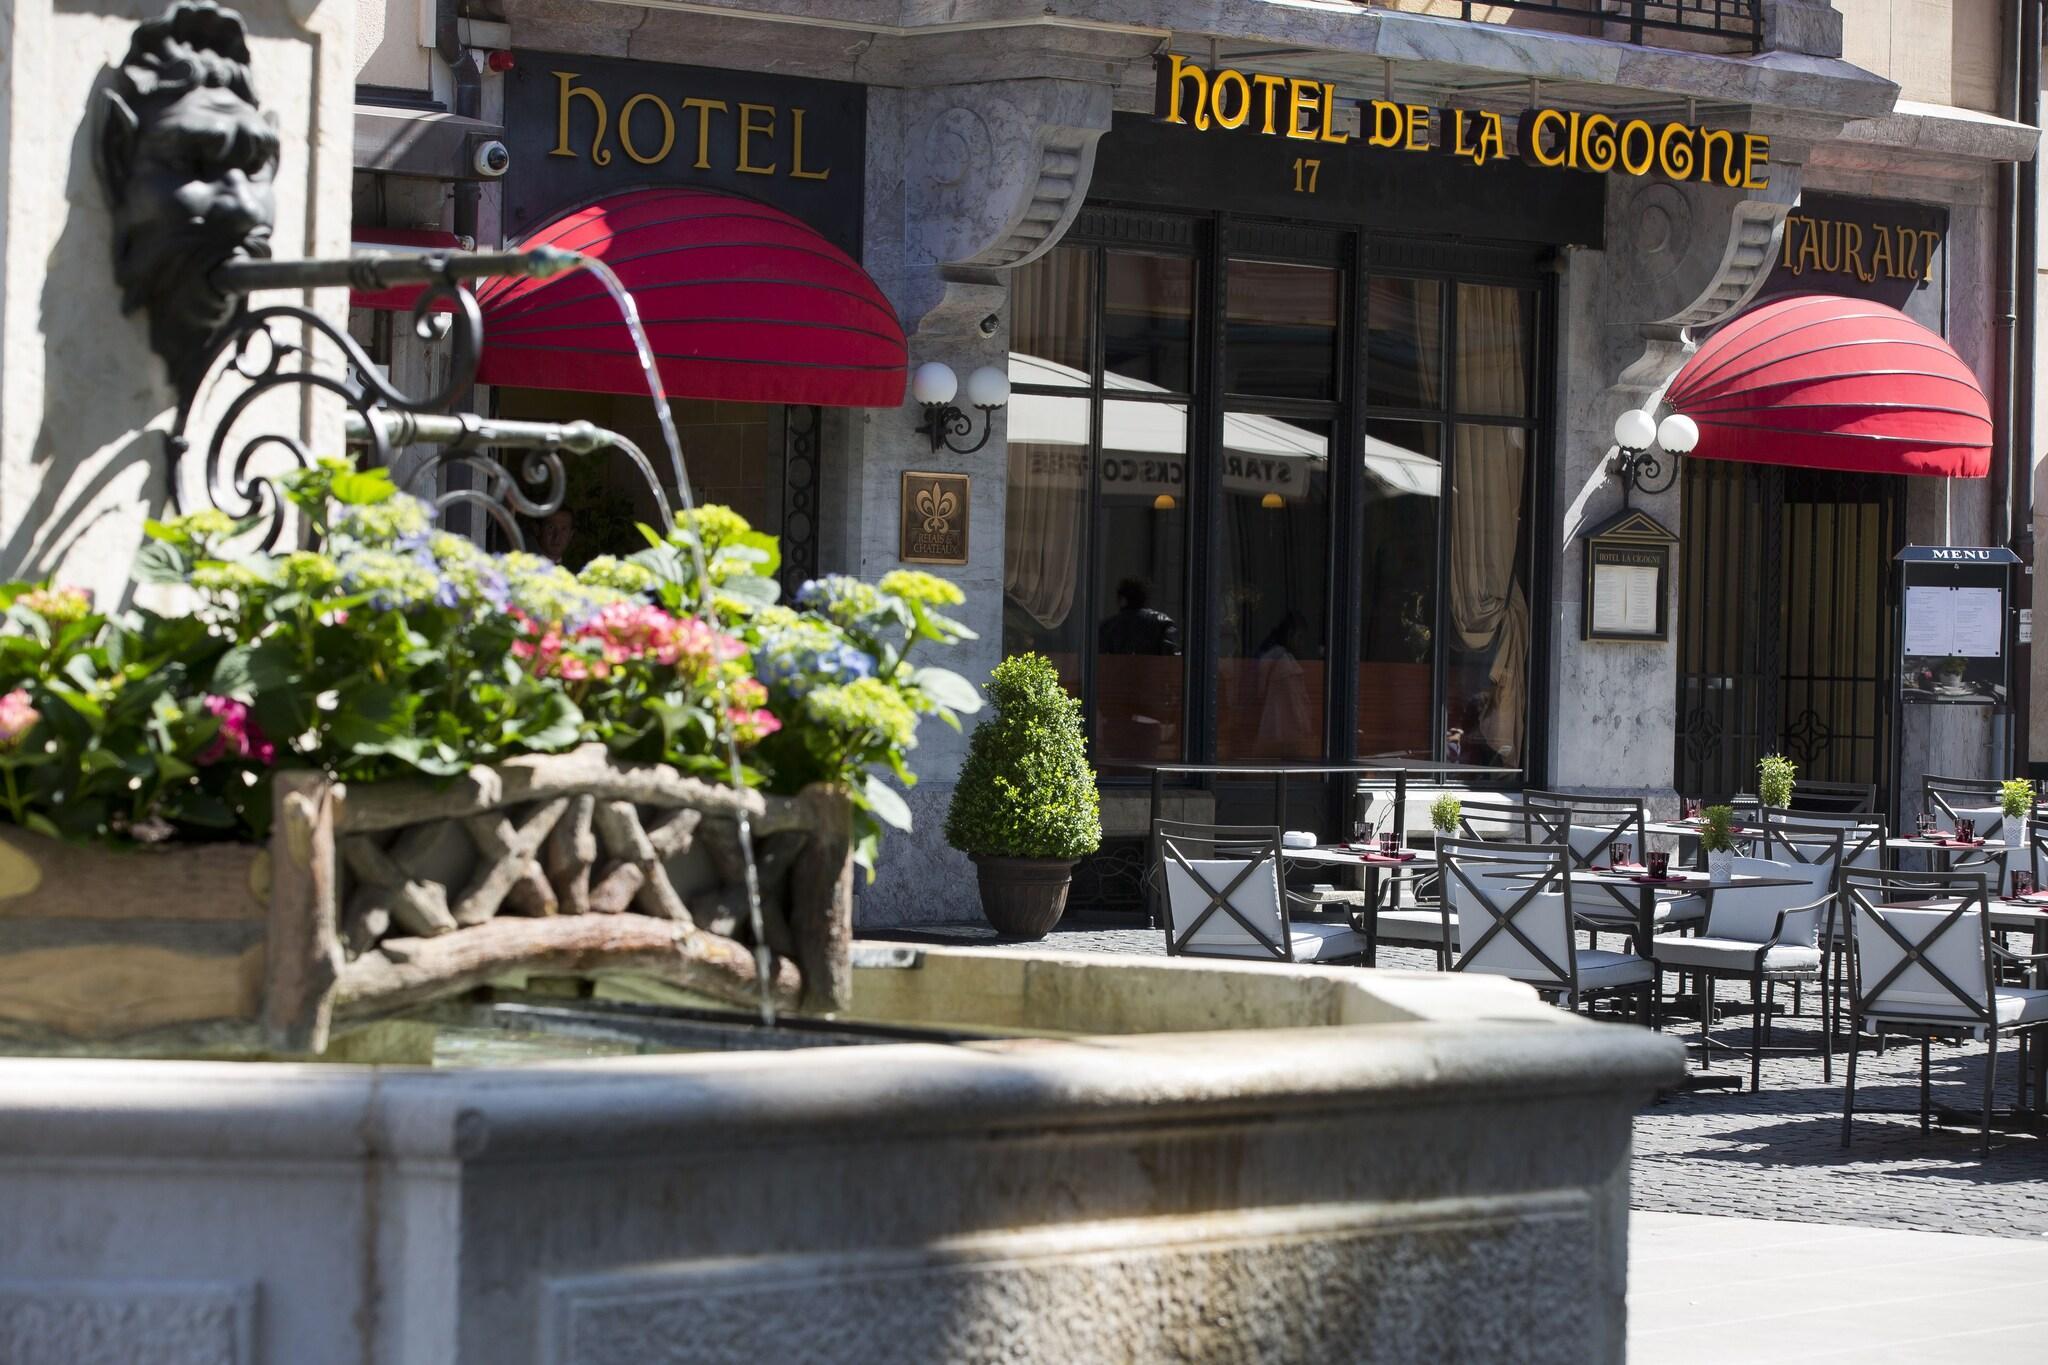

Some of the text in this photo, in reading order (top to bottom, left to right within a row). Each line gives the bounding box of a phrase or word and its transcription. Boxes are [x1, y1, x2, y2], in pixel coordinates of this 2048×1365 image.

[548, 71, 831, 180] HOTEL
[1165, 54, 1771, 190] HOTEL DE LA CIGOGNE
[1293, 157, 1321, 193] 17
[918, 533, 944, 544] RELAIS
[1599, 552, 1619, 562] HOTEL
[1932, 549, 1991, 560] MENU
